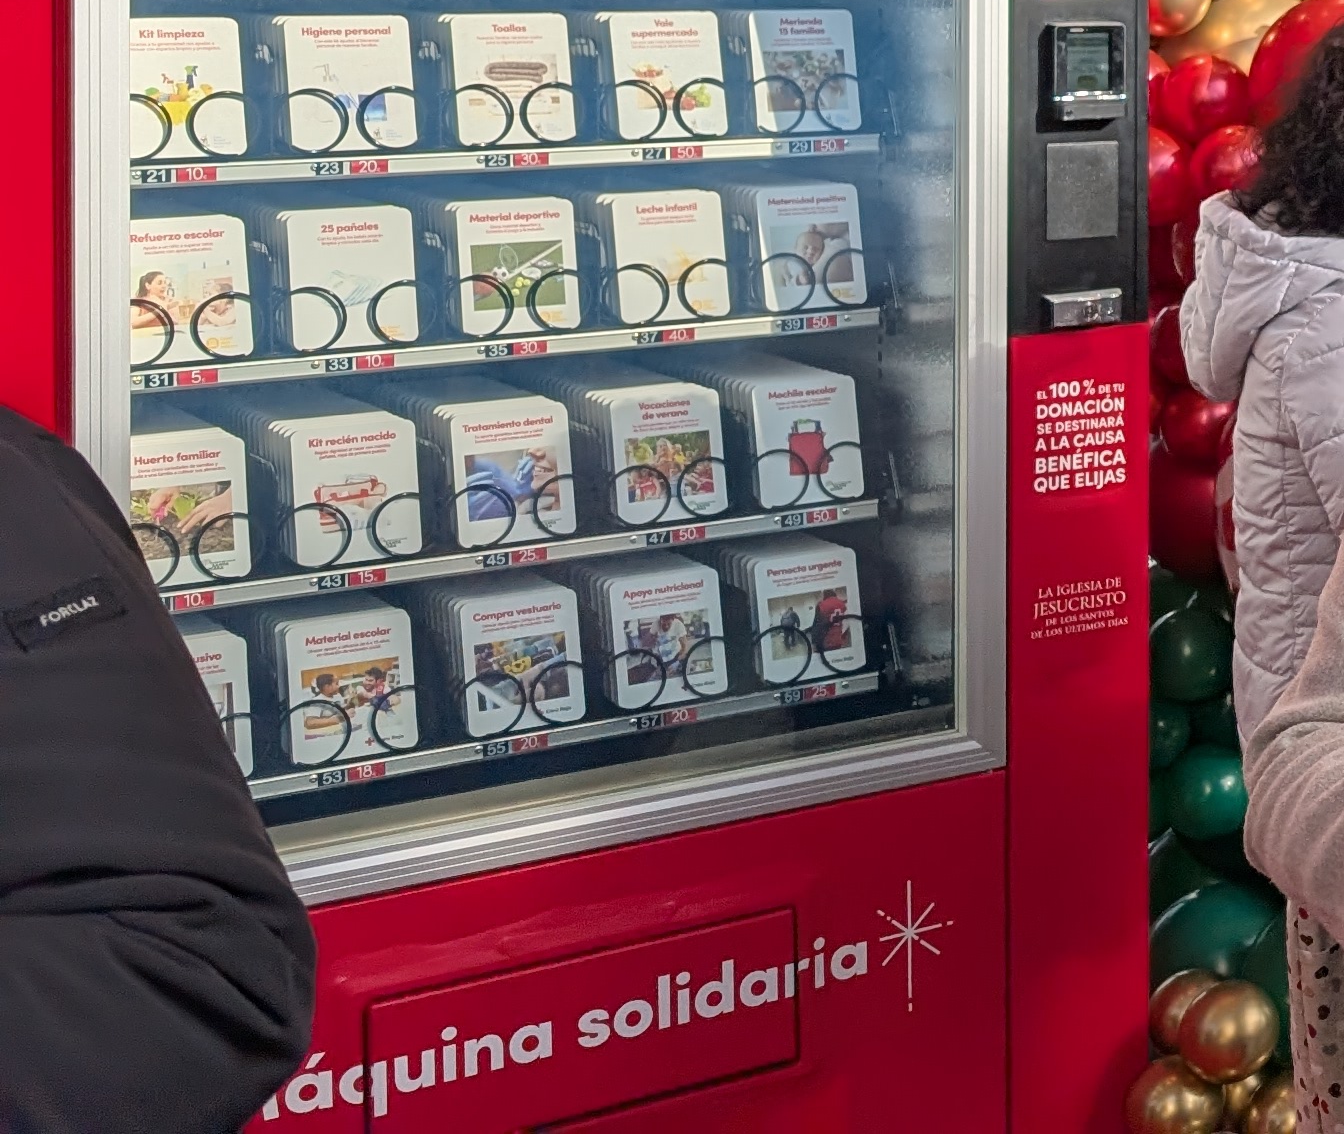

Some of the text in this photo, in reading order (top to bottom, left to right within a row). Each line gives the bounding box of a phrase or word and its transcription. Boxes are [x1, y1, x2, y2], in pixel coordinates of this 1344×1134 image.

[301, 26, 391, 39] Higiene personal
[492, 24, 527, 33] Toallas
[139, 29, 205, 42] Kit limpieza
[793, 141, 808, 152] 29
[645, 148, 661, 159] 27
[488, 155, 507, 166] 25
[147, 170, 166, 182] 21
[320, 163, 339, 176] 23
[635, 204, 664, 214] Leche
[469, 210, 560, 224] Material deportivo
[321, 222, 379, 235] 25 pañales
[130, 229, 225, 243] Refuerzo escolar
[785, 318, 800, 329] 39
[641, 332, 656, 343] 37
[488, 344, 507, 356] 35
[329, 359, 349, 370] 33
[149, 374, 168, 387] 31
[1036, 391, 1047, 399] EL
[1049, 381, 1080, 398] 100
[1098, 385, 1110, 394] DE
[1113, 383, 1125, 392] TU
[1036, 395, 1125, 419] DONACIÓN
[462, 415, 554, 433] Tratamiento dental
[1036, 413, 1125, 435] SE DESTINARÁ
[308, 430, 396, 448] Kit recién nacido
[1035, 430, 1125, 452] A LA CAUSA
[134, 450, 221, 466] Huerto familiar
[1035, 446, 1126, 474] BENÉFICA
[1033, 468, 1126, 493] QUE ELIJAS
[784, 515, 801, 526] 49
[649, 532, 666, 543] 47
[486, 554, 506, 565] 45
[321, 575, 341, 587] 43
[623, 588, 654, 601] Apoyo
[1038, 577, 1122, 599] LA IGLESIA DE
[39, 595, 99, 627] FORCLAZ
[1033, 591, 1126, 619] JESUCRISTO
[472, 610, 514, 623] Compra
[1045, 609, 1114, 626] DE LOS SANTOS
[305, 627, 392, 646] Material escolar
[641, 715, 658, 726] 57
[487, 742, 506, 755] 55
[322, 771, 342, 784] 53
[262, 937, 869, 1122] áquina solidaria
